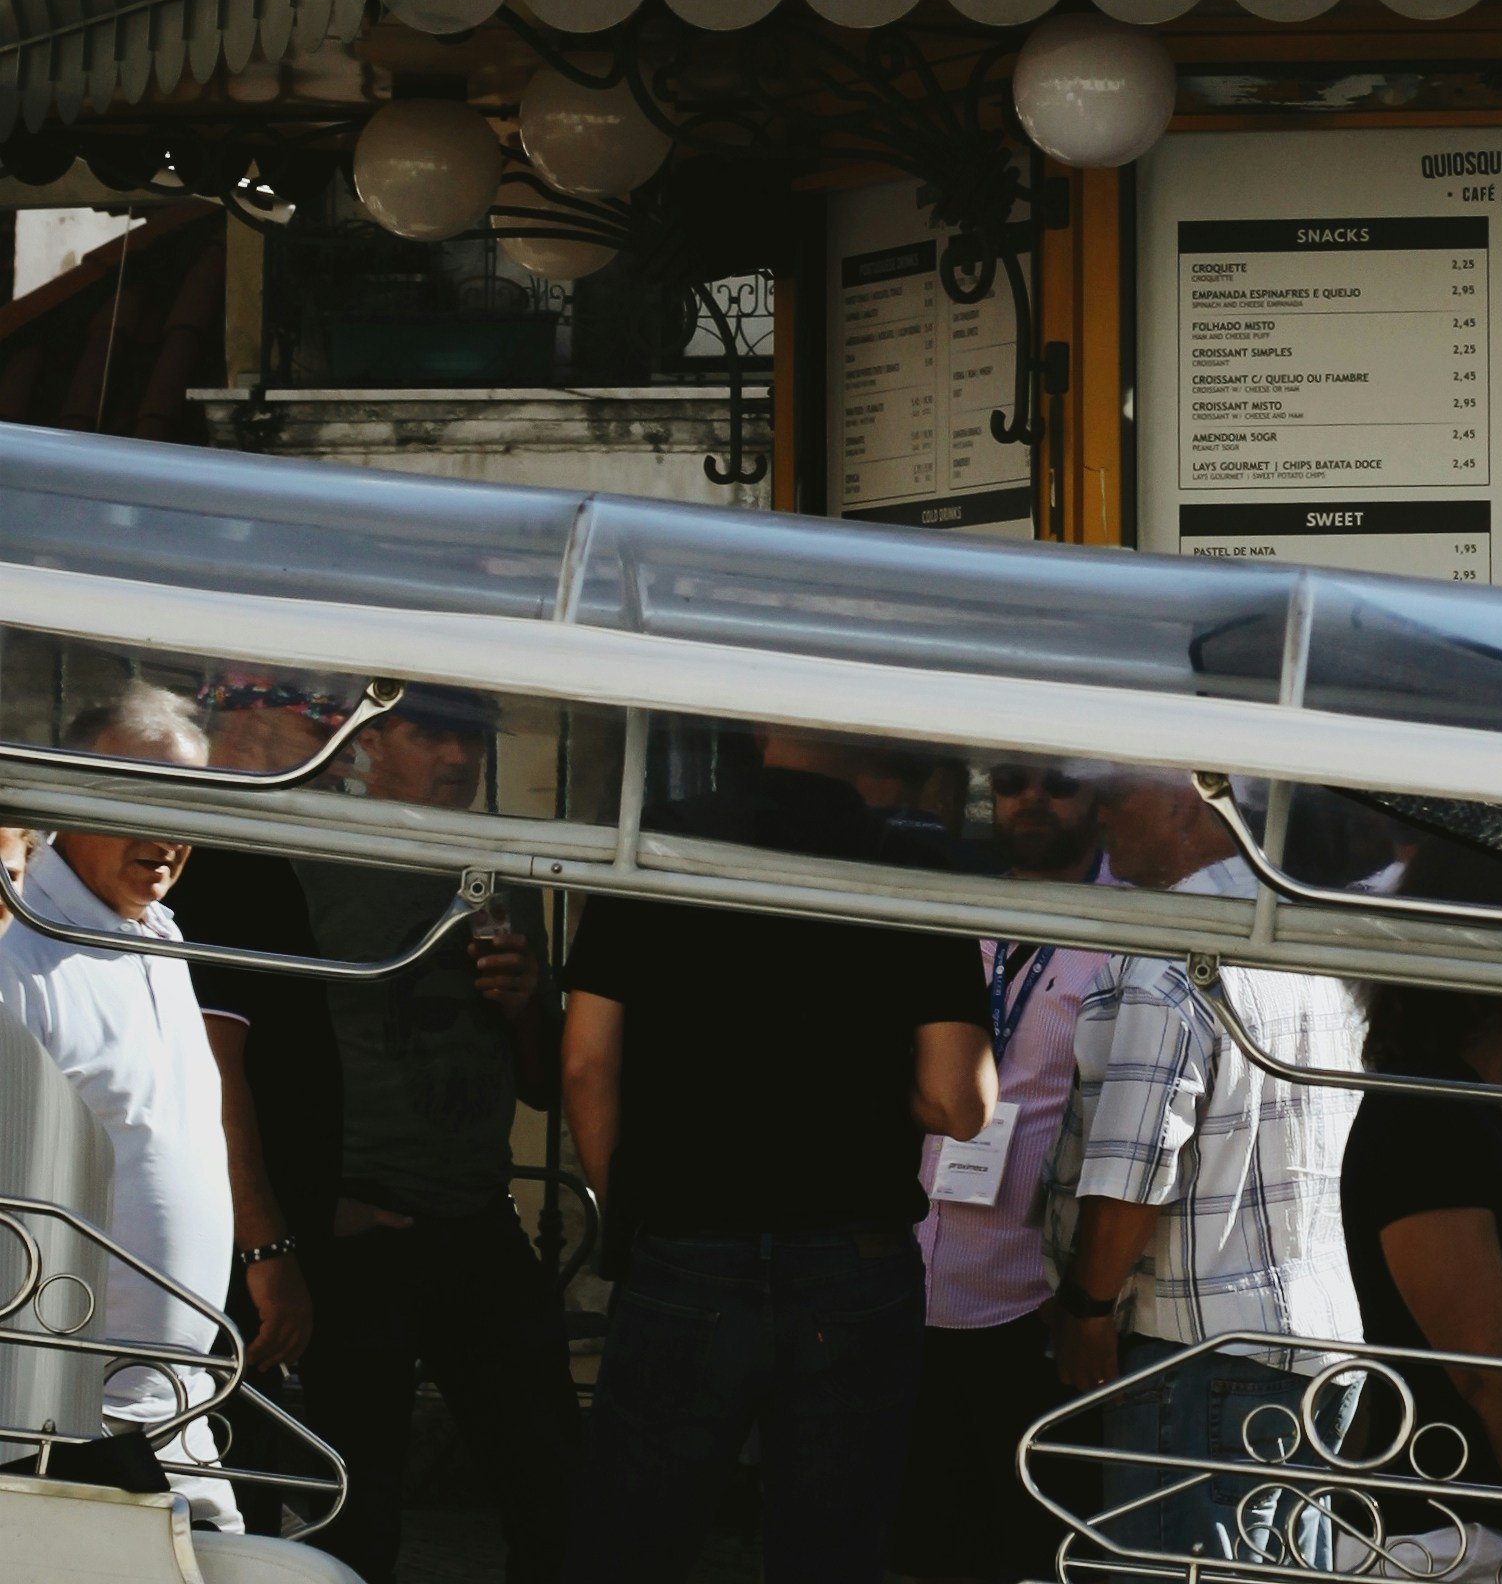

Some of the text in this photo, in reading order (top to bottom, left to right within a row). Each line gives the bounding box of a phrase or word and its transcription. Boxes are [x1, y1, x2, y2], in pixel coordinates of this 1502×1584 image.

[1463, 184, 1495, 202] CAFÉ
[1297, 229, 1369, 242] SNACKS
[1192, 264, 1246, 273] CROQUETE
[1452, 260, 1474, 269] 2,25
[1192, 288, 1361, 299] EMPANADA ESPINAFRES E QUEIJO
[1452, 285, 1474, 295] 2,95
[1192, 321, 1276, 331] FOLHADO MISTO
[1453, 318, 1475, 327] 2,45
[1192, 348, 1292, 357] CROISSANT SIMPLES
[1453, 345, 1476, 354] 2,25
[1192, 373, 1368, 384] CROISSANT C/ QUEIJO OU FIAMBRE
[1454, 372, 1476, 381] 2,45
[1192, 402, 1282, 411] CROISSANT MISTO
[1454, 399, 1476, 407] 2,95
[1192, 433, 1277, 442] AMENDOIM 50GR
[1453, 430, 1475, 439] 2,45
[1193, 460, 1381, 471] LAYS GOURMET CHIPS BATATA DOCE
[1453, 459, 1475, 468] 2,45
[922, 506, 961, 523] COLD DRINKS
[1307, 513, 1363, 526] SWEET
[1193, 547, 1275, 558] PASTEL DE NATA
[1455, 544, 1476, 553] 1,95
[1453, 571, 1476, 580] 2,95
